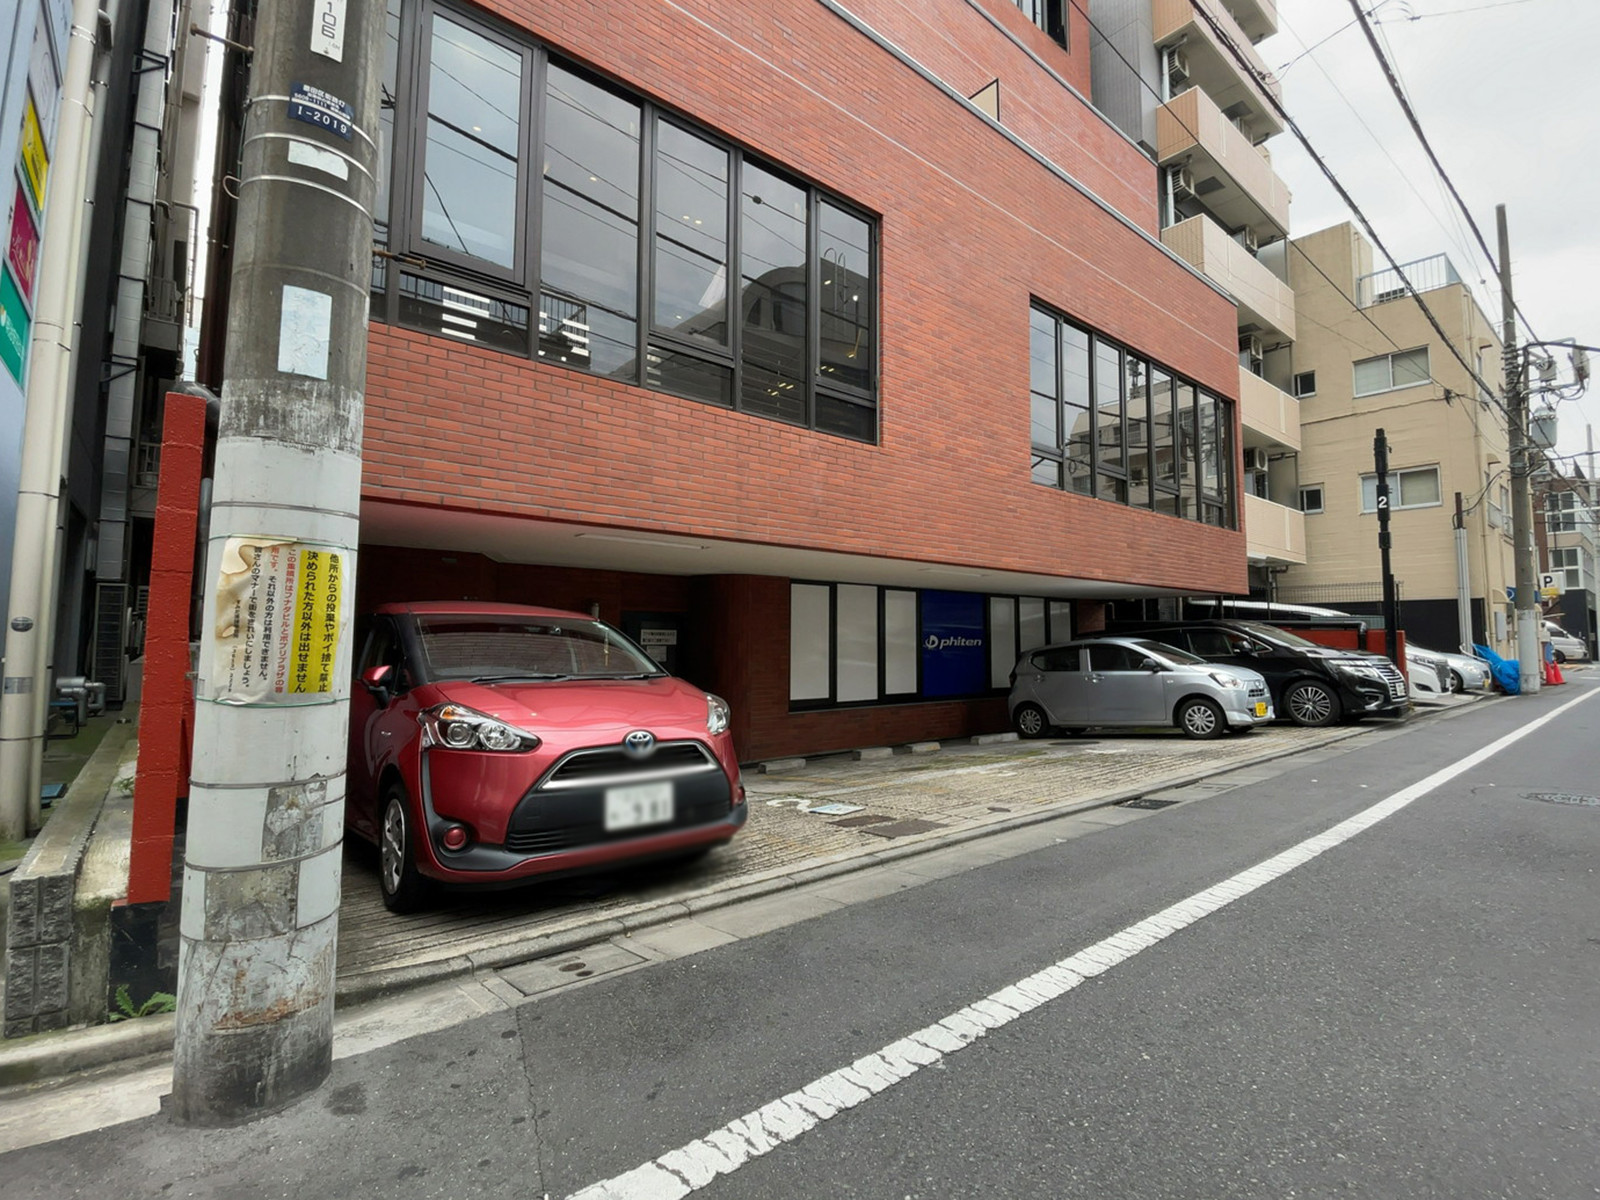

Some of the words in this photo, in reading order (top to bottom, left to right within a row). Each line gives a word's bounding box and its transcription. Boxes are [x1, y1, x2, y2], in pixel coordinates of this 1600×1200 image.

[1378, 495, 1388, 509] 2
[1543, 576, 1553, 588] P
[295, 551, 319, 693] 決められた方以外は出せません
[318, 553, 340, 693] 他所からの投棄やポイ捨て禁止
[939, 636, 982, 650] phiten
